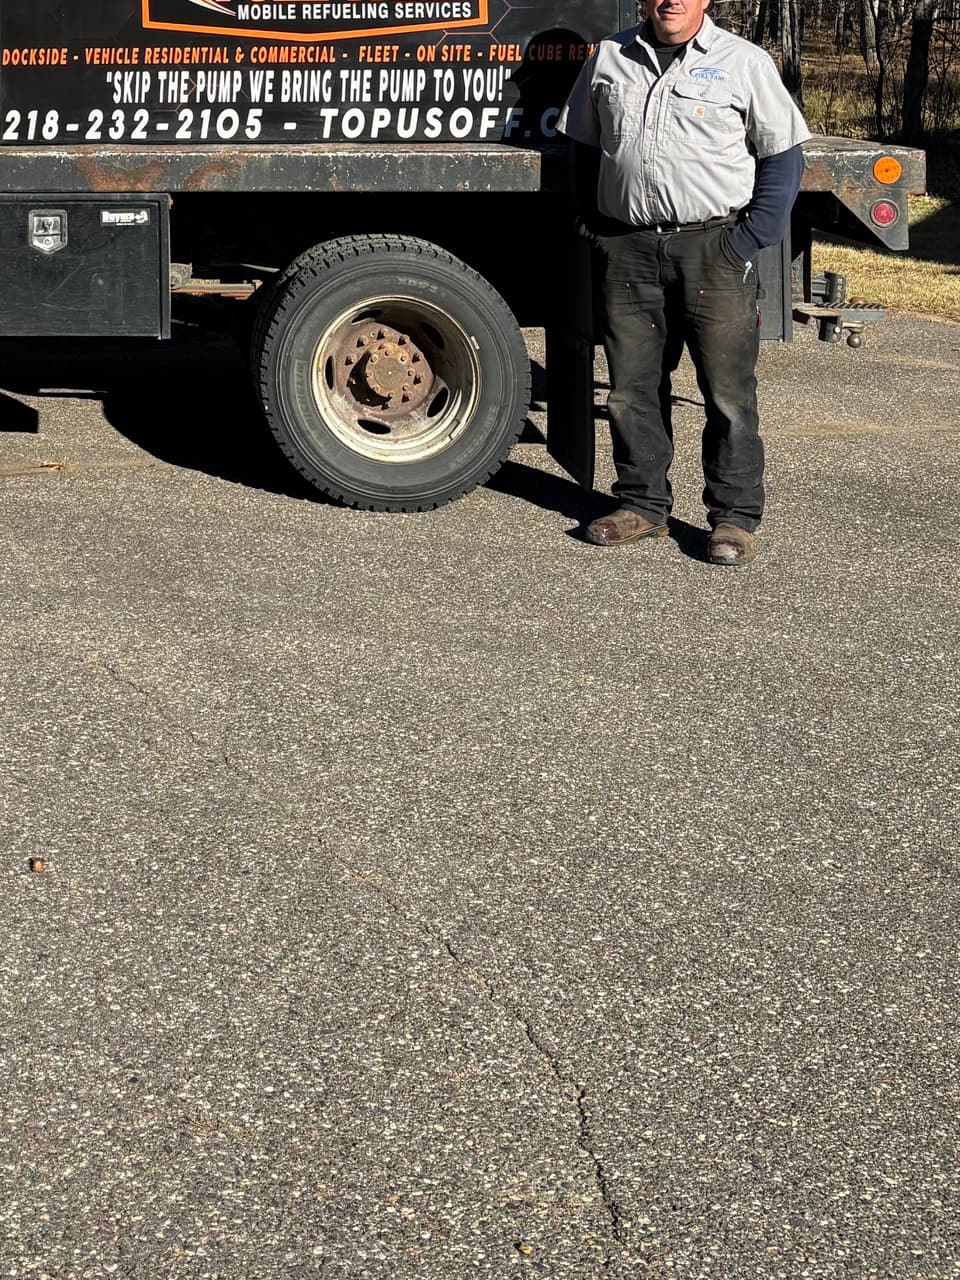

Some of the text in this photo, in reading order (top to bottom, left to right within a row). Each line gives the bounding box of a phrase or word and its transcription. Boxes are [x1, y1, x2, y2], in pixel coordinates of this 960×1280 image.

[238, 2, 472, 20] MOBILE REFUELING SERVICES
[2, 48, 68, 65] DOCKSIDE
[85, 48, 139, 65] VEHICLE
[144, 47, 229, 64] RESIDENTIAL
[235, 47, 245, 64] &
[250, 45, 336, 64] COMMERCIAL
[358, 45, 399, 63] FLEET
[416, 45, 436, 62] ON
[441, 45, 472, 62] SITE
[489, 44, 522, 61] FUEL
[528, 44, 562, 61] CUBE
[106, 65, 511, 103] "SKIP THE PUMP WE BRING THE PUMP TO YOU!"
[2, 108, 263, 140] 218-232-2105
[320, 106, 560, 139] TOPUSOFF.C
